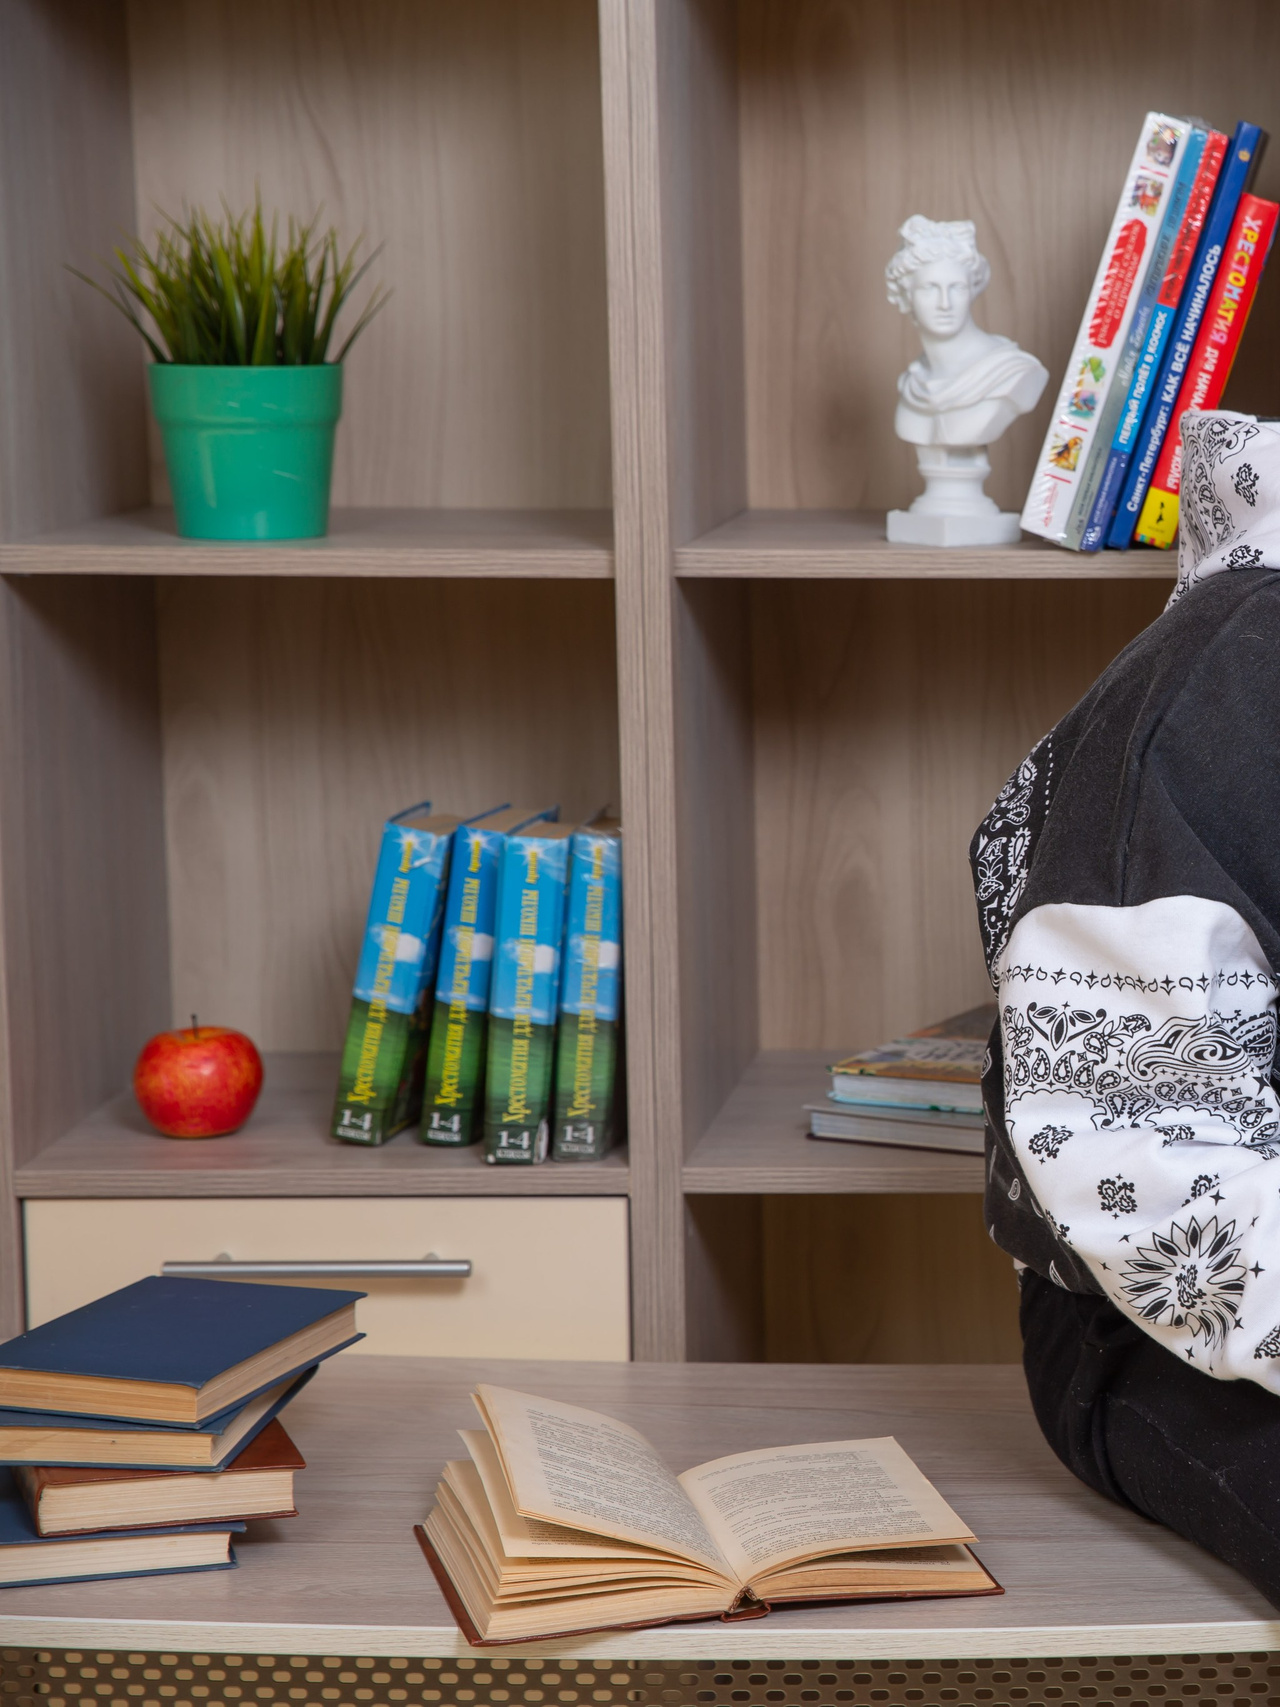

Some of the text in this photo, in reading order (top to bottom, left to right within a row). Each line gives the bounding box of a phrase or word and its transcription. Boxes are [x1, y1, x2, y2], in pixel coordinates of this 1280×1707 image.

[1180, 244, 1221, 341] НАЧИНАЛОСЬ
[1208, 215, 1262, 344] ХРЕСТОМАТИЯ
[1146, 310, 1167, 353] КОСМОС
[1143, 353, 1154, 363] В
[1171, 342, 1190, 373] ВСЁ
[1201, 344, 1219, 371] ДЛЯ
[1132, 363, 1151, 398] ПОЛЁТ
[1161, 373, 1181, 403] КАК
[1118, 397, 1140, 444] ПЕРВЫЙ
[1126, 404, 1170, 512] Санкт-Петербург:
[346, 1021, 382, 1105] Хрестоматия
[387, 877, 409, 923] школы
[434, 1023, 463, 1106] Хрестоматия
[460, 877, 479, 923] школы
[502, 1038, 531, 1123] Хрестоматия
[520, 889, 538, 935] школы
[566, 1033, 595, 1117] Хрестоматия
[585, 885, 603, 930] школы
[342, 1109, 372, 1131] 1-4
[431, 1112, 461, 1132] 1-4
[498, 1130, 531, 1149] 1-4
[563, 1125, 594, 1144] 1-4
